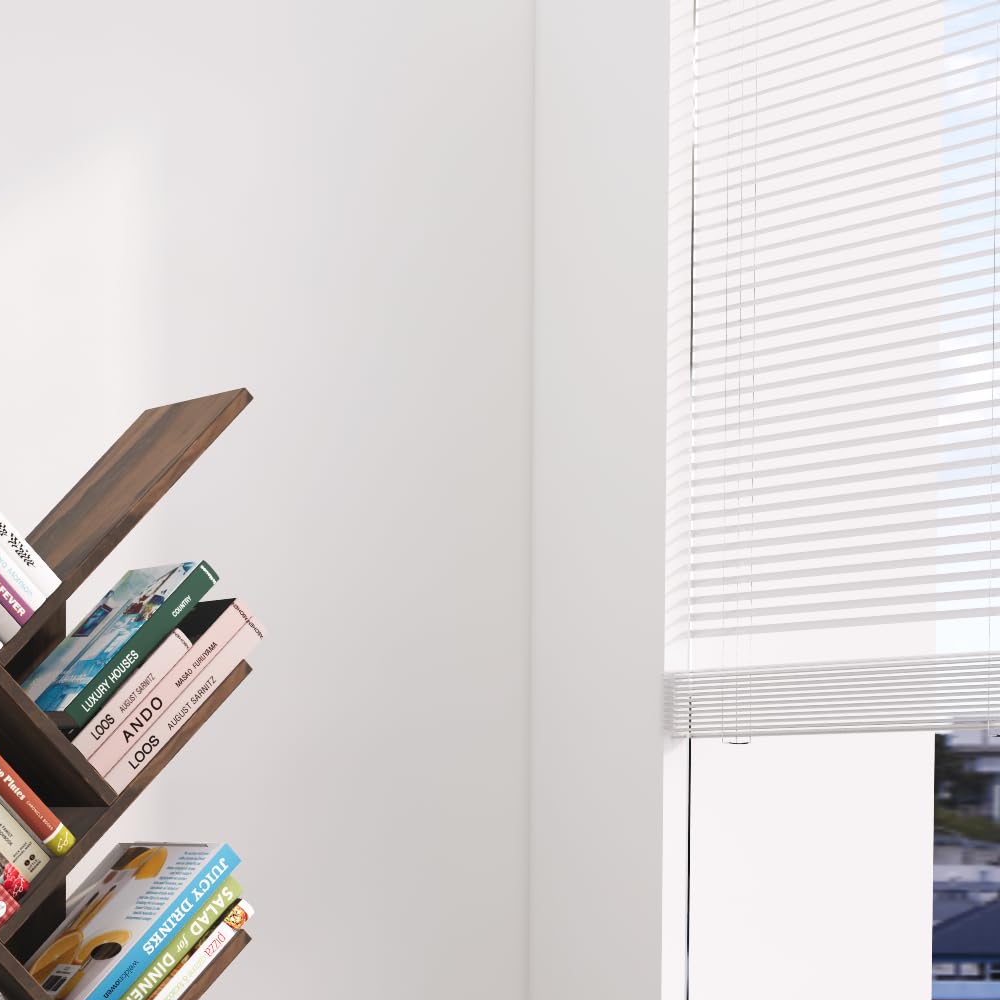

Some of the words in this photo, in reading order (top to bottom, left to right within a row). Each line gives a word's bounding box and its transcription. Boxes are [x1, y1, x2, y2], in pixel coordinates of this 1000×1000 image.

[171, 595, 192, 618] COUNTRY
[81, 679, 112, 712] LUXURY
[109, 650, 139, 684] HOUSES
[174, 668, 193, 688] MASAO
[192, 641, 218, 669] FURUYAMA
[90, 714, 116, 741] LOOS
[119, 693, 138, 713] AUGUST
[135, 672, 155, 695] SARNITZ
[122, 696, 163, 743] ANDO
[167, 703, 192, 731] AUGUST
[190, 675, 217, 705] SARNITZ
[128, 735, 160, 770] LOOS
[3, 773, 26, 801] Plates
[191, 858, 229, 902] JUICY
[142, 897, 194, 955] DRINKS
[190, 887, 233, 936] SALAD
[176, 935, 189, 953] for
[204, 931, 226, 957] pizza
